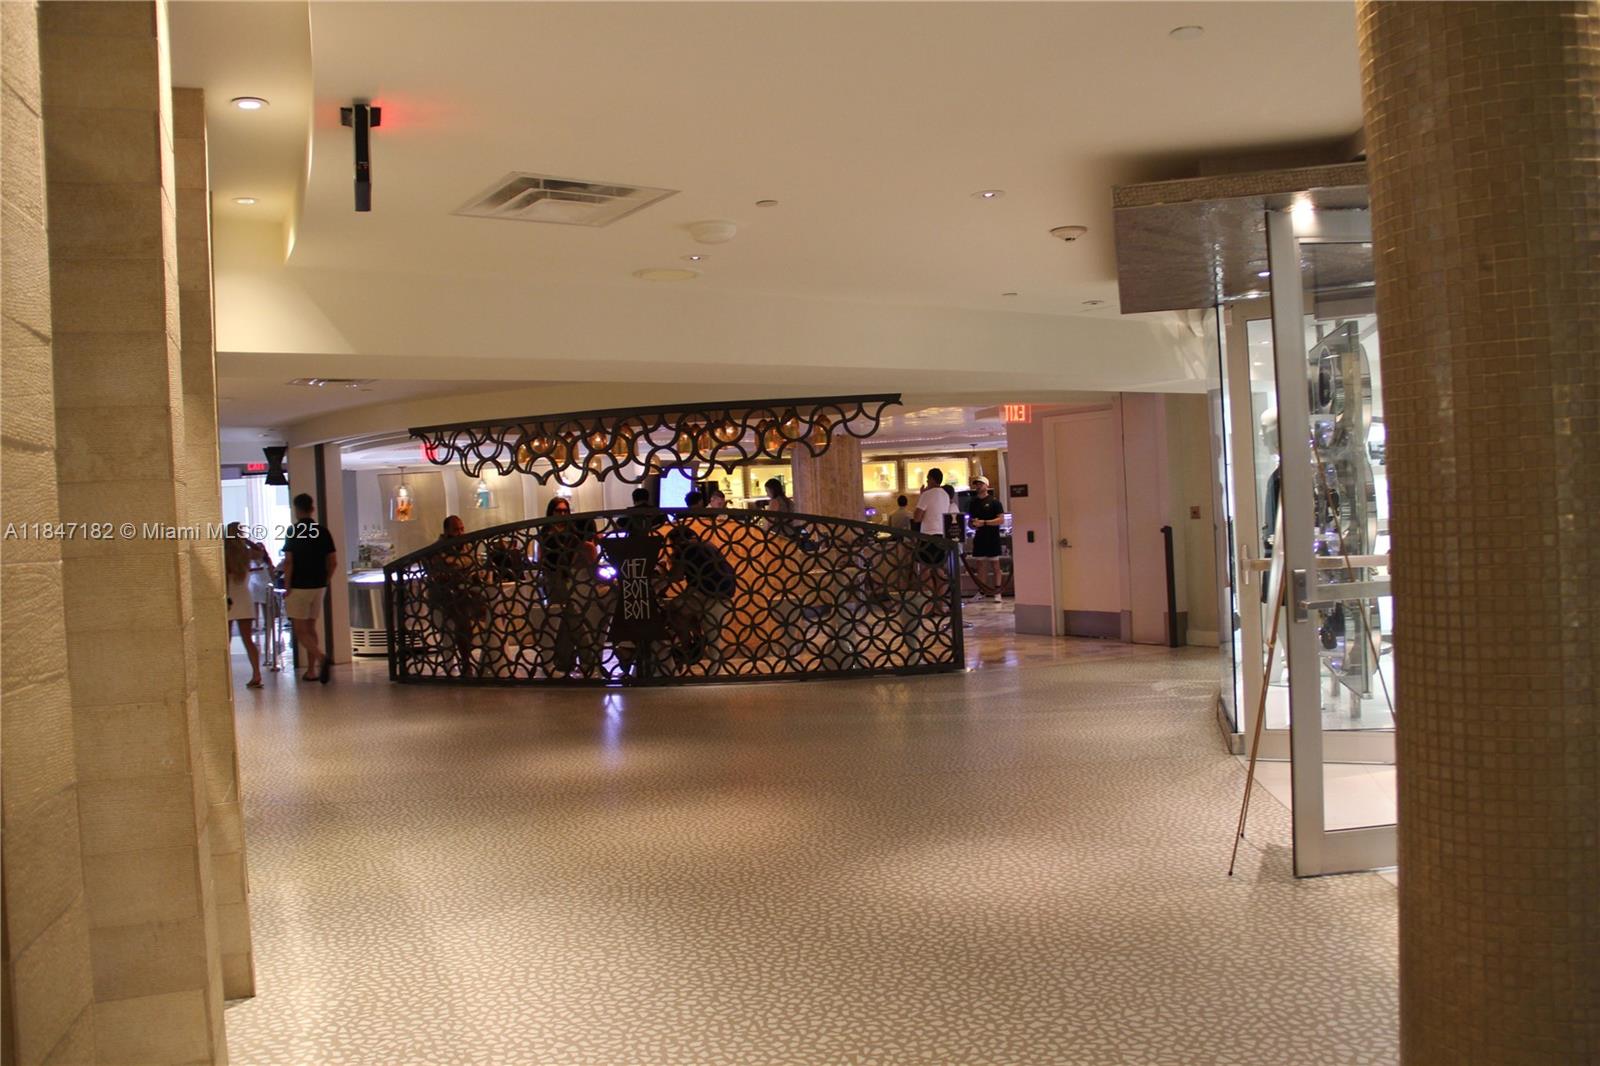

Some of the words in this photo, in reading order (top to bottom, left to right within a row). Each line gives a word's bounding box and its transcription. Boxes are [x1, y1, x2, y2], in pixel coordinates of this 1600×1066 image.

[621, 558, 648, 579] CHEZ
[623, 579, 649, 599] BON
[624, 600, 650, 620] BON
